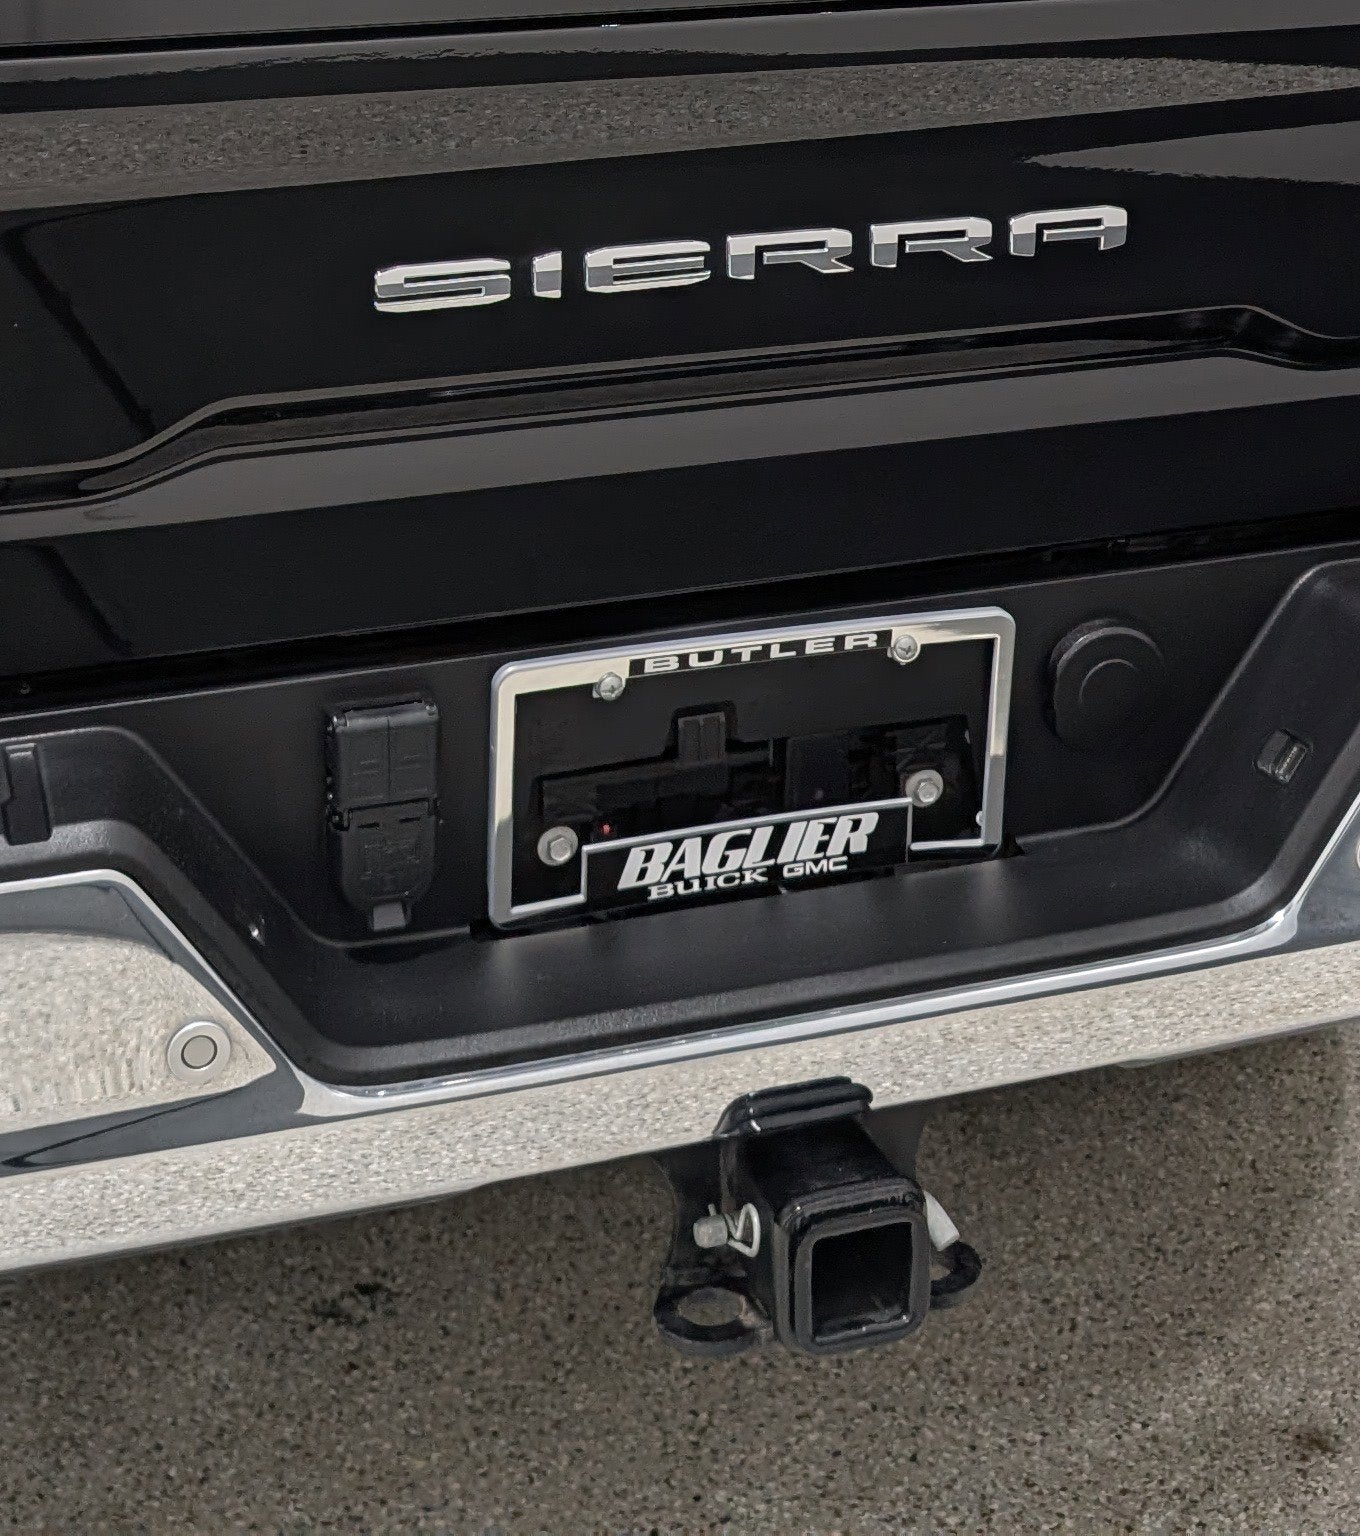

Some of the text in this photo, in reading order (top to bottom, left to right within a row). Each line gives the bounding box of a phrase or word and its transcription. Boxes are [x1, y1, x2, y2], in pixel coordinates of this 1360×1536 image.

[374, 205, 1128, 312] SIERRA
[644, 633, 878, 674] BUTLER
[617, 812, 879, 891] BAGLIER
[647, 855, 848, 901] BUICK GMC
